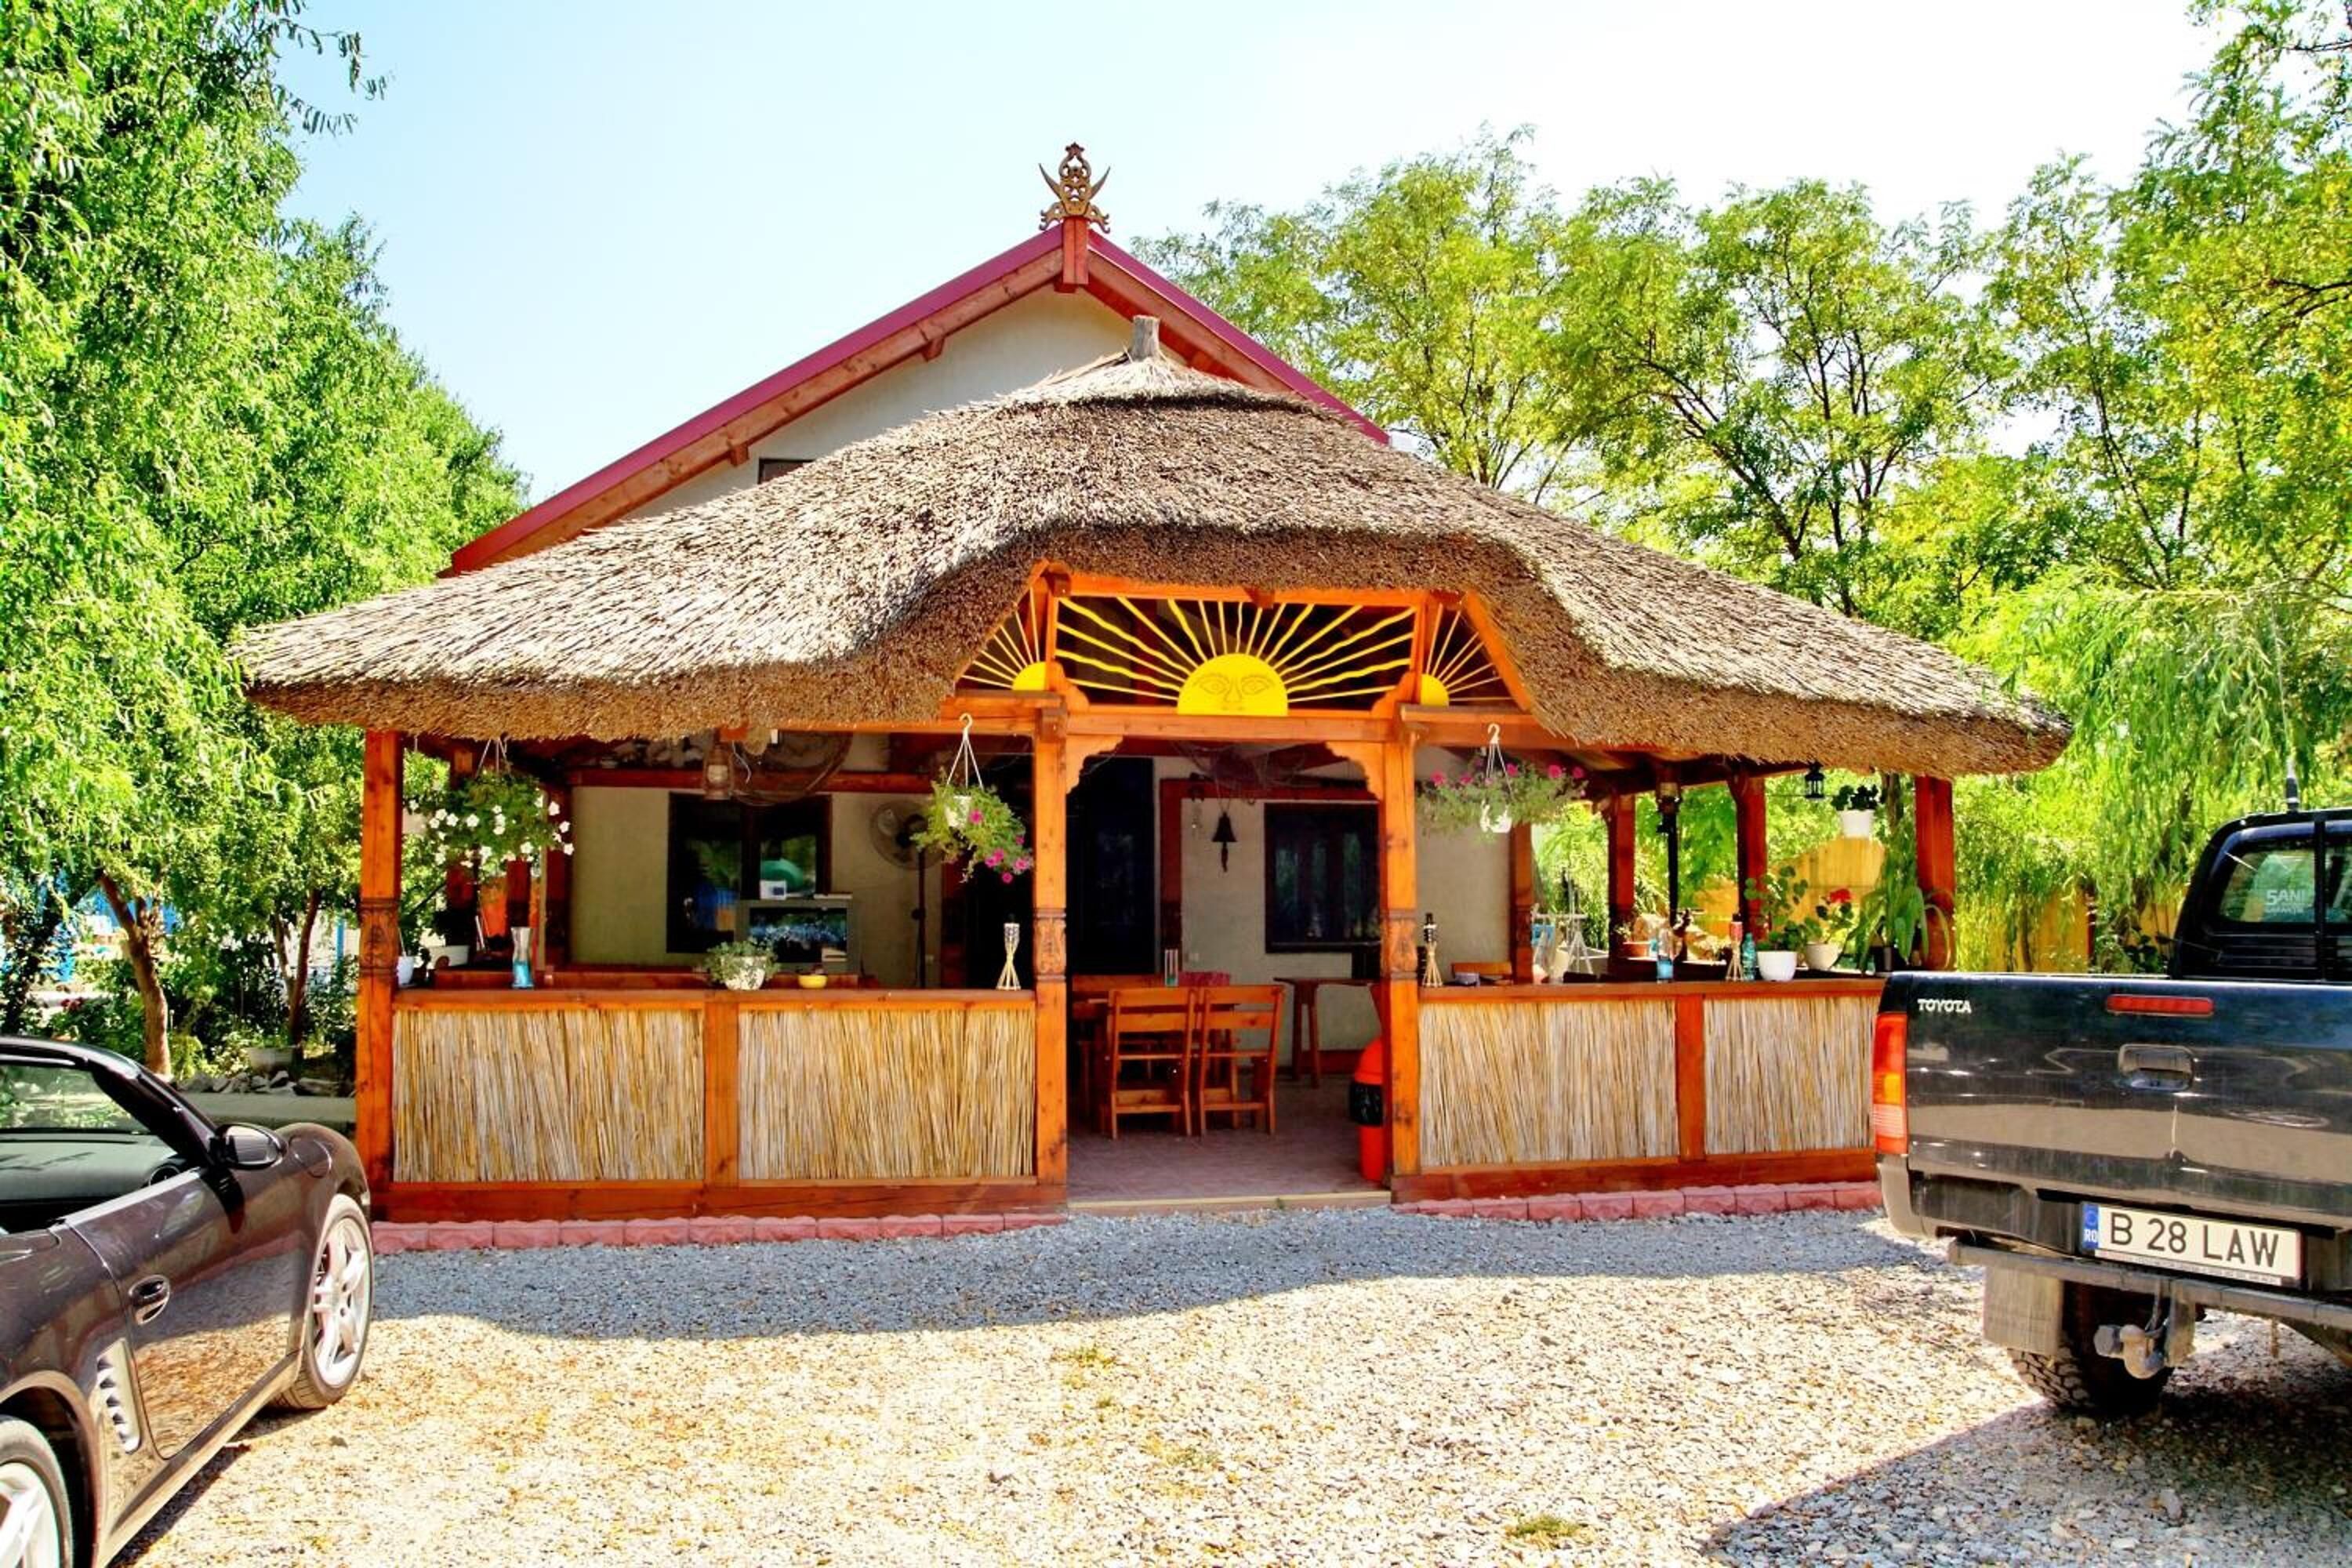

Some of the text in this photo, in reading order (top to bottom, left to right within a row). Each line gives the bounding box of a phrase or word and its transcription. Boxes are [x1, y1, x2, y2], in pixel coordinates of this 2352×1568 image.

[1917, 998, 1972, 1014] TOYOTA
[2084, 1229, 2098, 1243] RO
[2111, 1212, 2279, 1268] B 28 LAW
